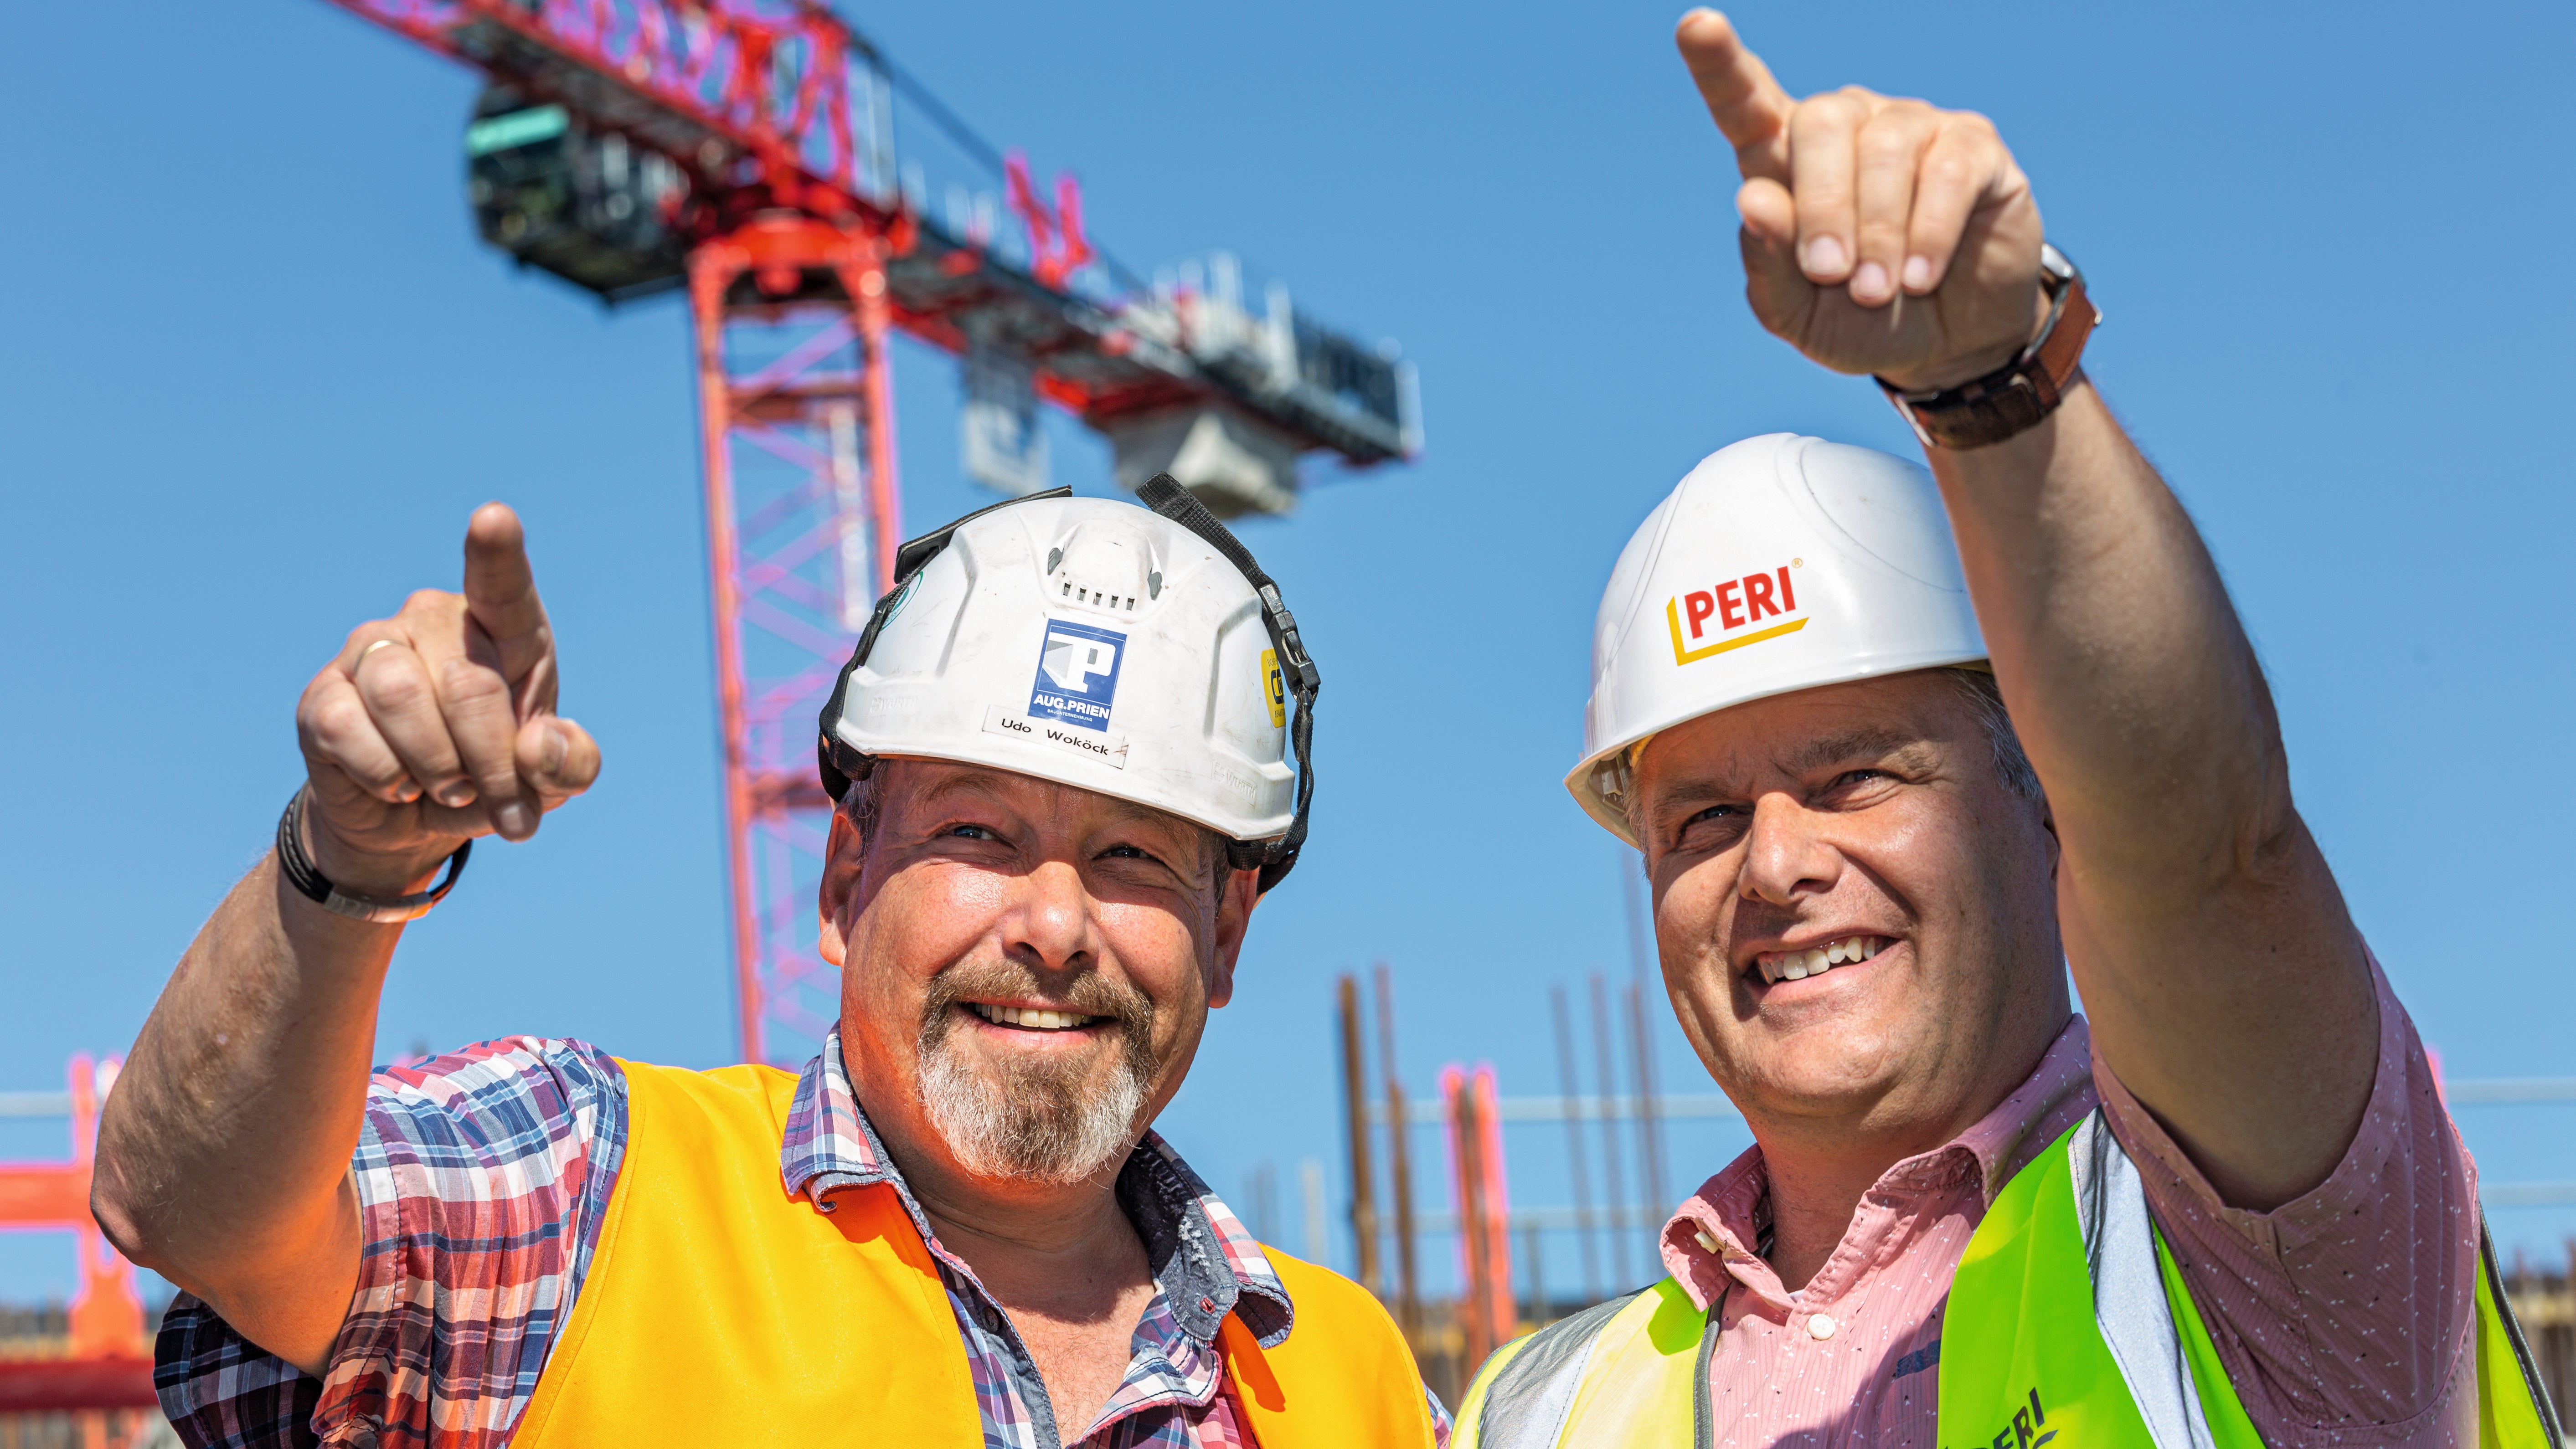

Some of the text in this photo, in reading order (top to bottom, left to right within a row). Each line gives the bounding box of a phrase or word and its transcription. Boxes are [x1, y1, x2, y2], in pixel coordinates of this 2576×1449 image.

[1033, 694, 1110, 719] AUG.PRIEN
[1047, 709, 1093, 722] BAUUNTERNEHMUNG
[1001, 718, 1109, 755] Udo Woköck
[1972, 1386, 2045, 1449] RI
